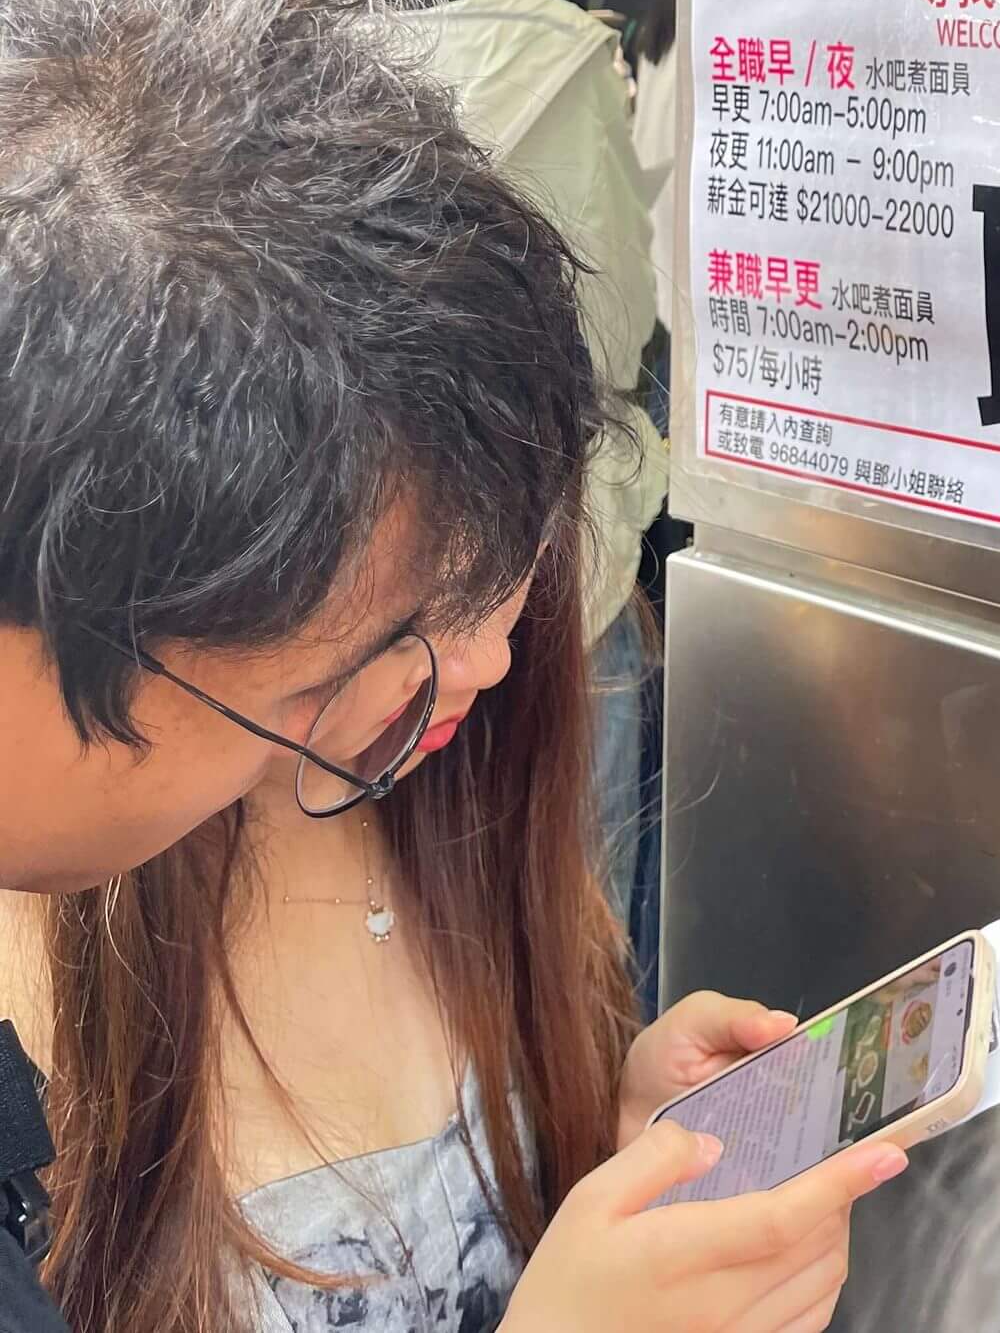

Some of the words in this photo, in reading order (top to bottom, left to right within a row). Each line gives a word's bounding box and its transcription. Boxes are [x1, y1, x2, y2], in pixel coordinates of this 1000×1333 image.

[865, 57, 971, 96] 水吧煮面員
[711, 84, 751, 123] 早更
[710, 129, 749, 171] 夜更
[756, 136, 835, 175] 11:00am
[873, 147, 954, 194] 9:00pm
[707, 175, 788, 222] 薪金可達
[708, 248, 823, 311] 兼職早更
[831, 278, 936, 325] 水吧煮面員
[709, 296, 751, 337] 時間
[713, 342, 823, 396] $75/每小時
[717, 429, 765, 461] 或致電
[769, 441, 849, 477] 96844079
